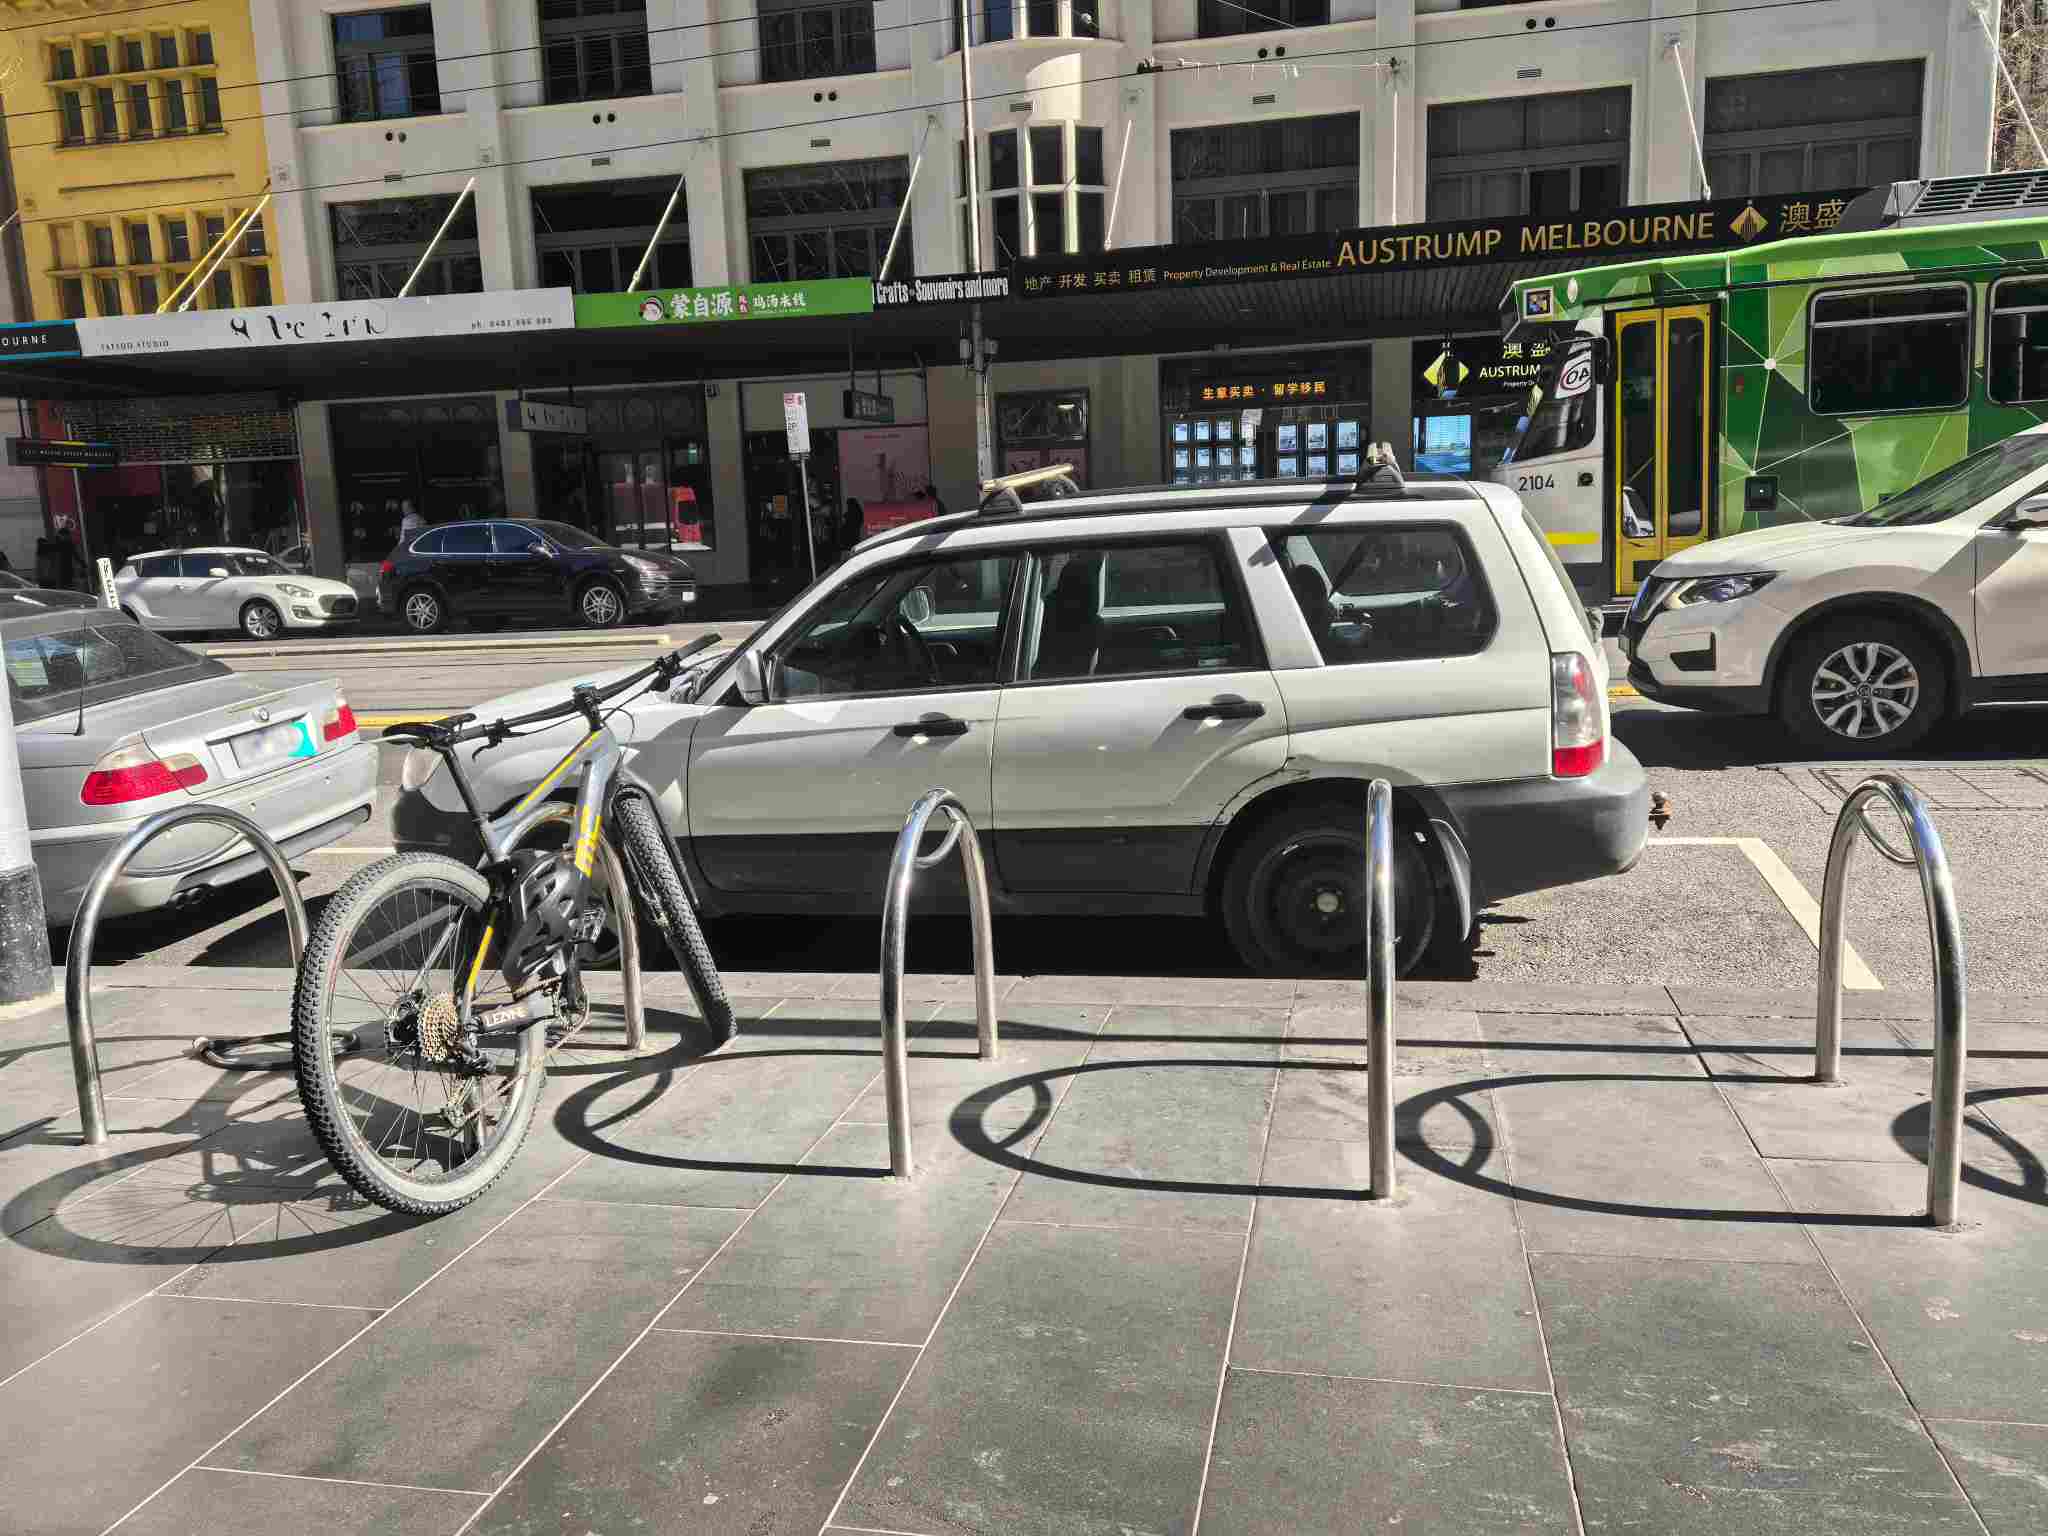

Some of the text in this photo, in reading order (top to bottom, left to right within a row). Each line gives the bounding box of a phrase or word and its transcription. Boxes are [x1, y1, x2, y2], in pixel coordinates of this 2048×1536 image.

[1778, 199, 1845, 233] 澳盛
[1337, 211, 1715, 267] AUSTRUMP MELBOURNE
[1057, 272, 1088, 288] 开发
[1093, 271, 1121, 287] 买卖
[1163, 270, 1203, 281] Property
[1205, 264, 1269, 281] Development
[1280, 260, 1300, 272] Real
[1302, 258, 1331, 270] Estate
[877, 276, 1009, 305] Crafts Souvenirs and more
[1518, 475, 1555, 491] 2104
